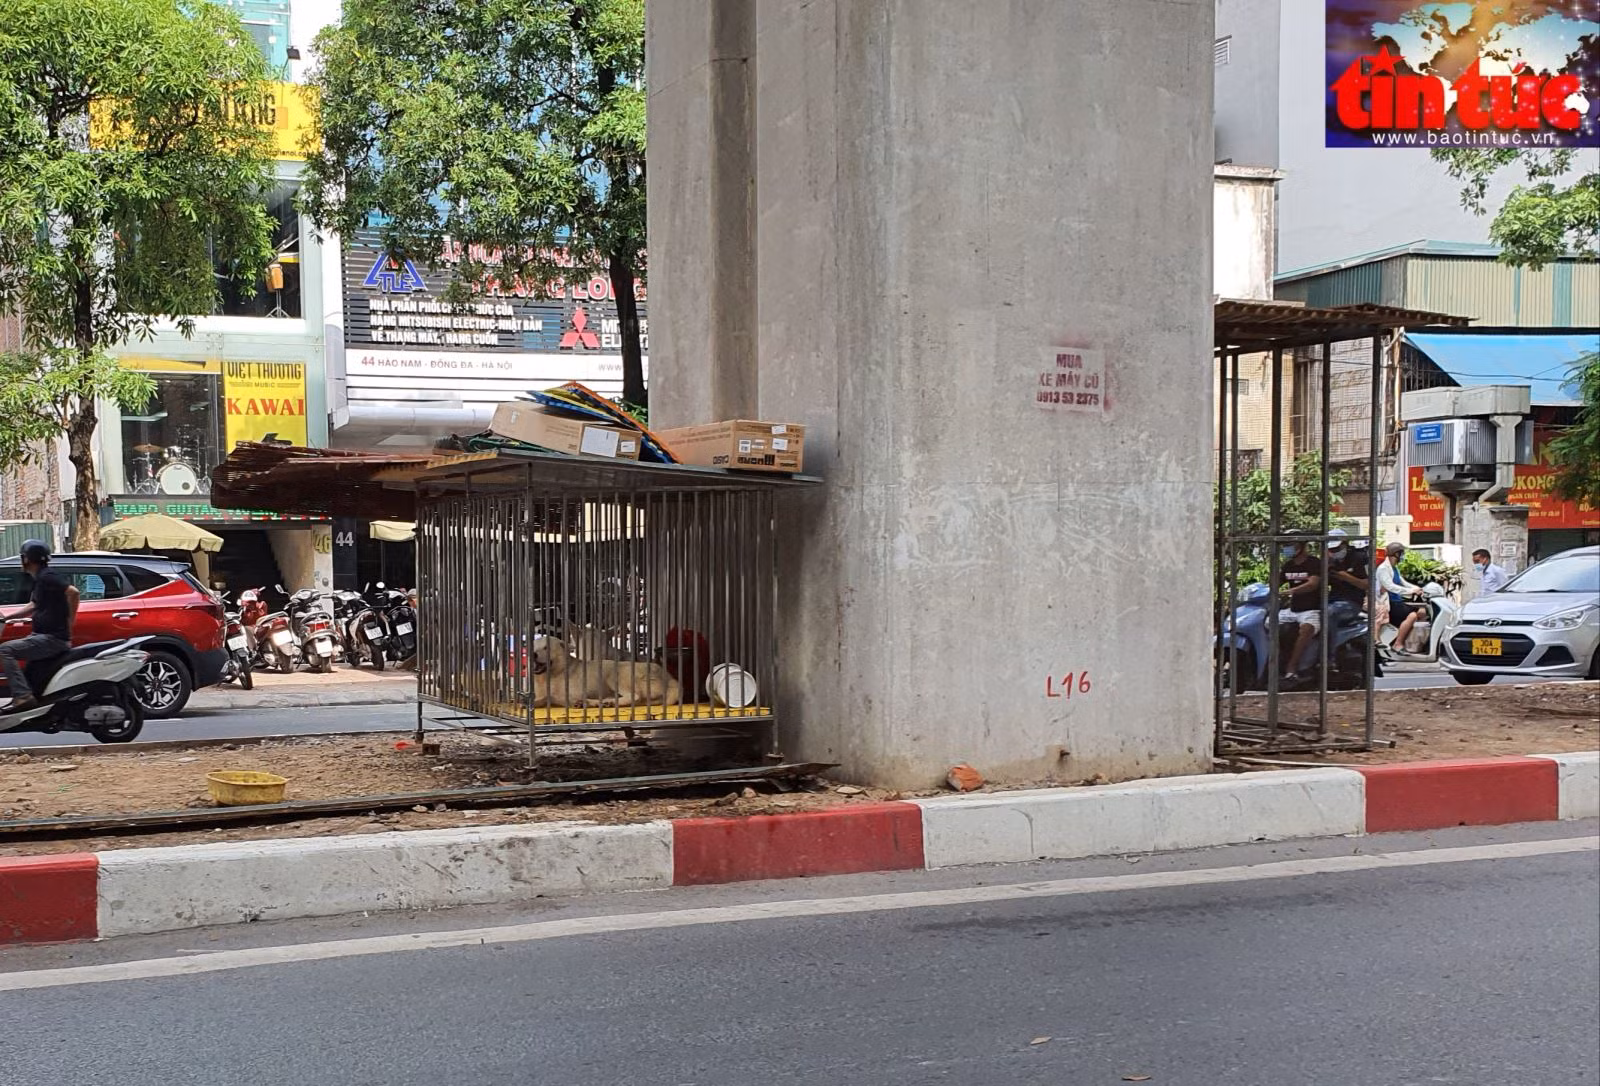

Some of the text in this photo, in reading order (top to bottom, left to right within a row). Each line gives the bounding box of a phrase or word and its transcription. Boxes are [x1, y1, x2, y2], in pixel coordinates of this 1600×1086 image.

[398, 315, 451, 328] MITSUBISHI
[361, 356, 375, 366] 44
[400, 359, 422, 368] NAM
[1056, 354, 1083, 369] MUA
[1056, 371, 1081, 387] MÁY
[227, 397, 305, 416] KAWAI
[314, 531, 354, 554] 46 44
[1047, 671, 1091, 699] L16
